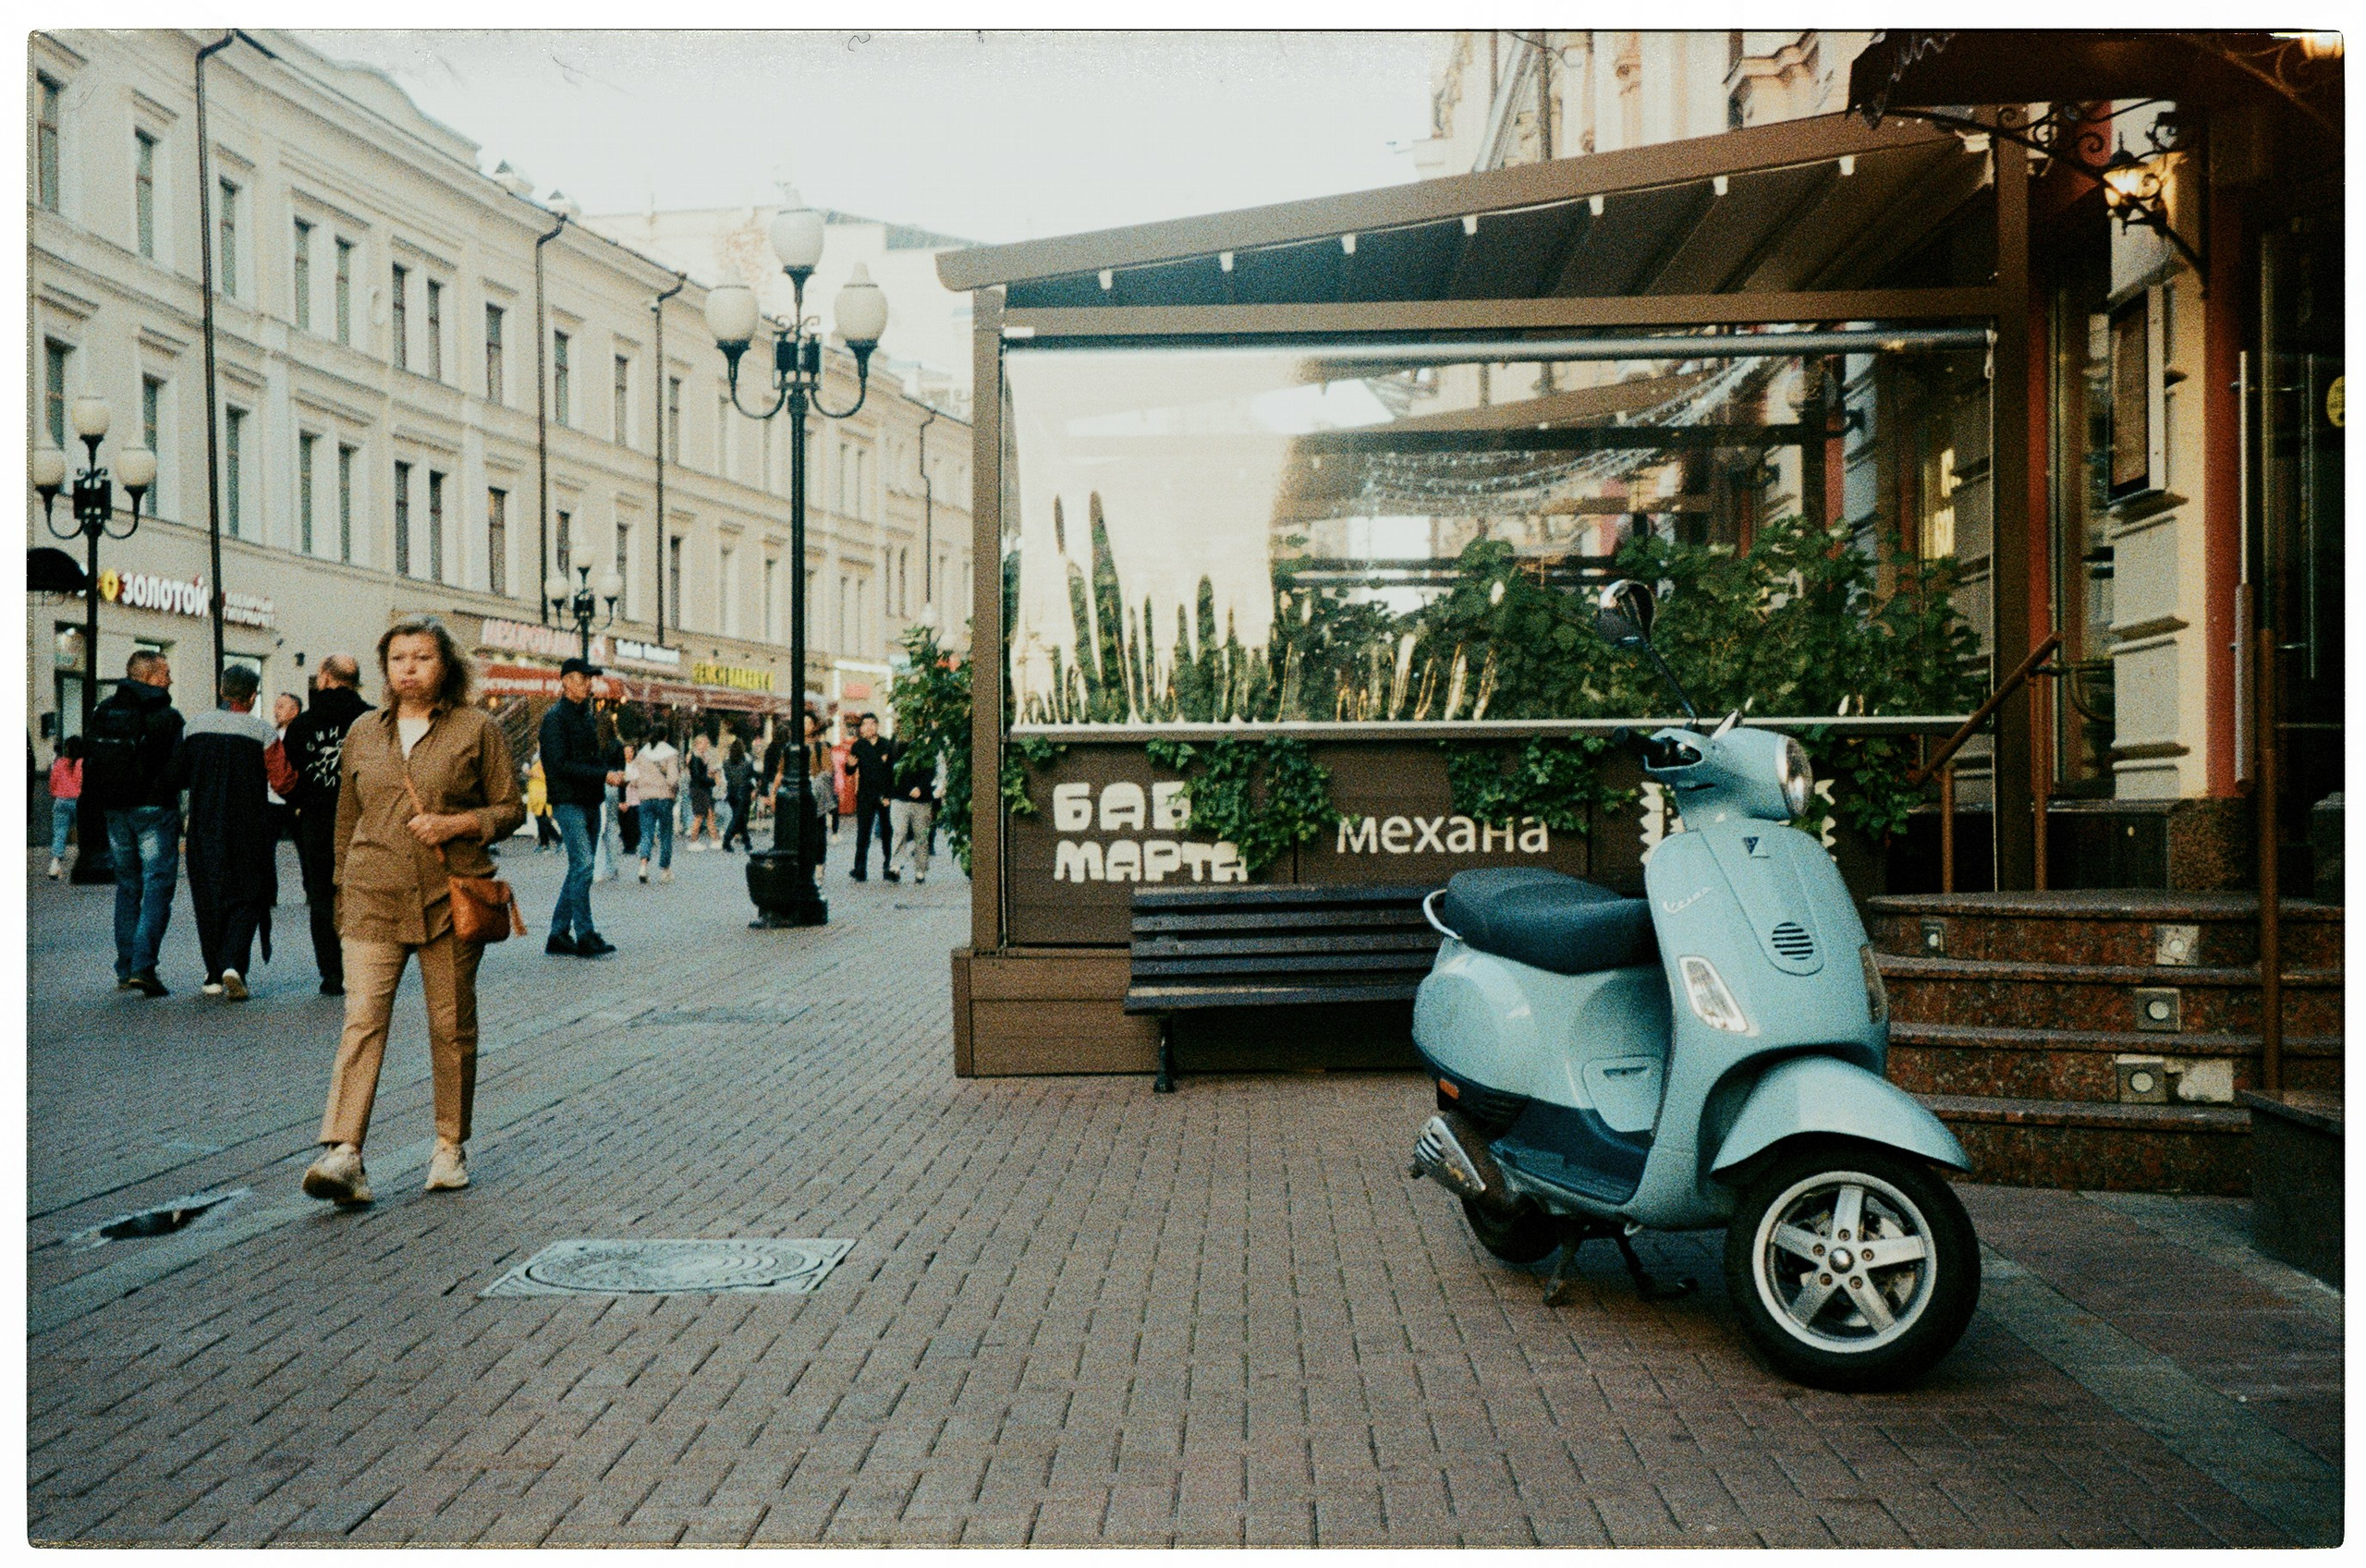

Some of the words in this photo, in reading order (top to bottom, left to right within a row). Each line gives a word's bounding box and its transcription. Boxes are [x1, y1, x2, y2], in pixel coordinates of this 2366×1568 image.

[121, 572, 209, 617] ЗОЛОТОЙ
[1053, 782, 1191, 832] БАБ
[1336, 815, 1549, 855] механа
[1054, 840, 1248, 883] МАРТА
